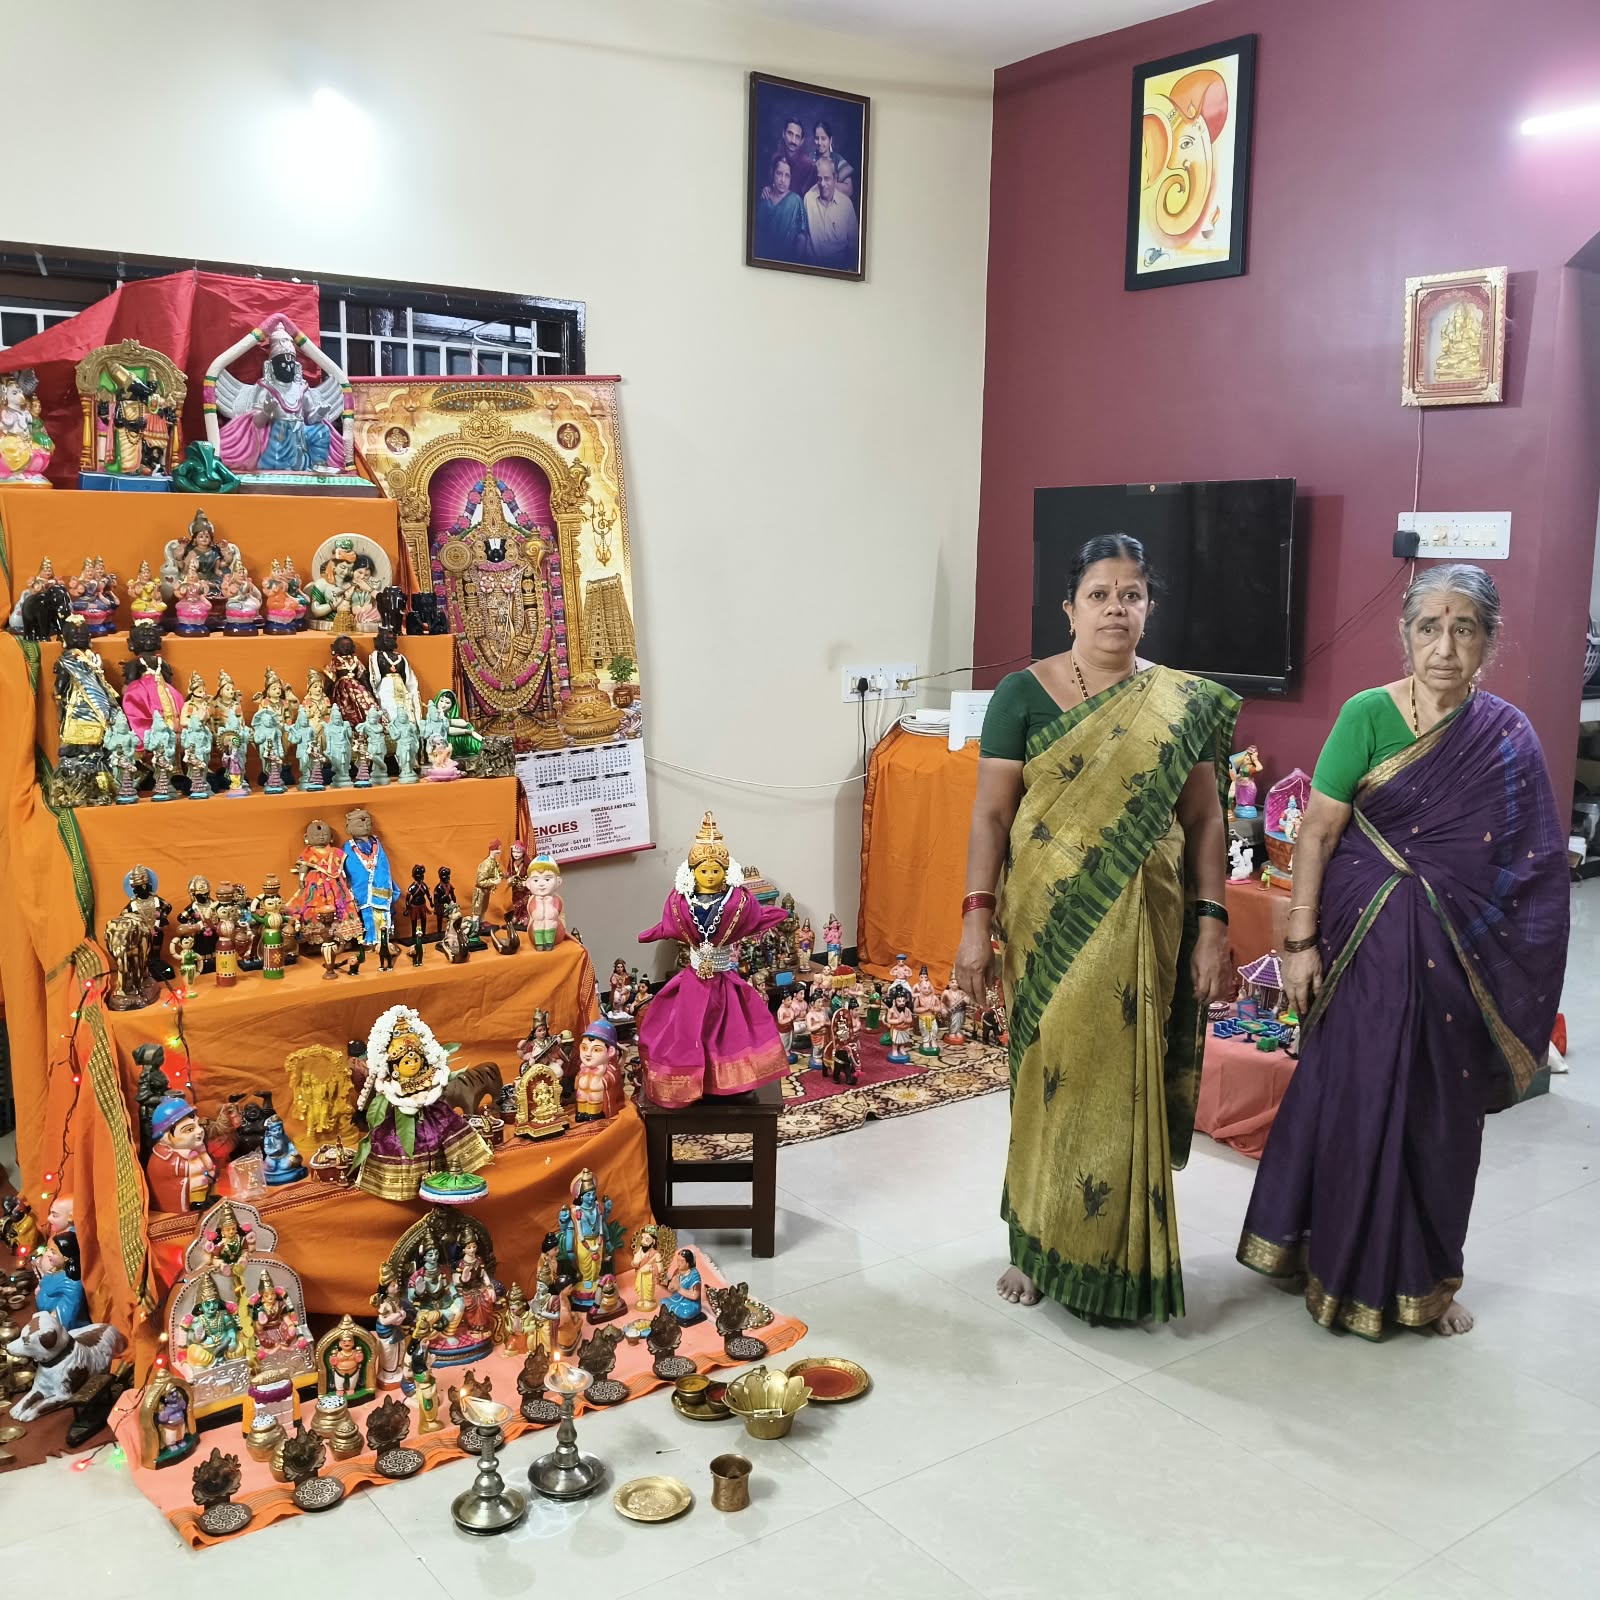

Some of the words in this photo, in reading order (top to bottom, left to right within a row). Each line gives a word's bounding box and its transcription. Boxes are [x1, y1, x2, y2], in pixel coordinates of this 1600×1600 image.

[533, 820, 578, 837] ENCIES
[552, 847, 569, 855] BLACK
[570, 843, 591, 852] COLOUR
